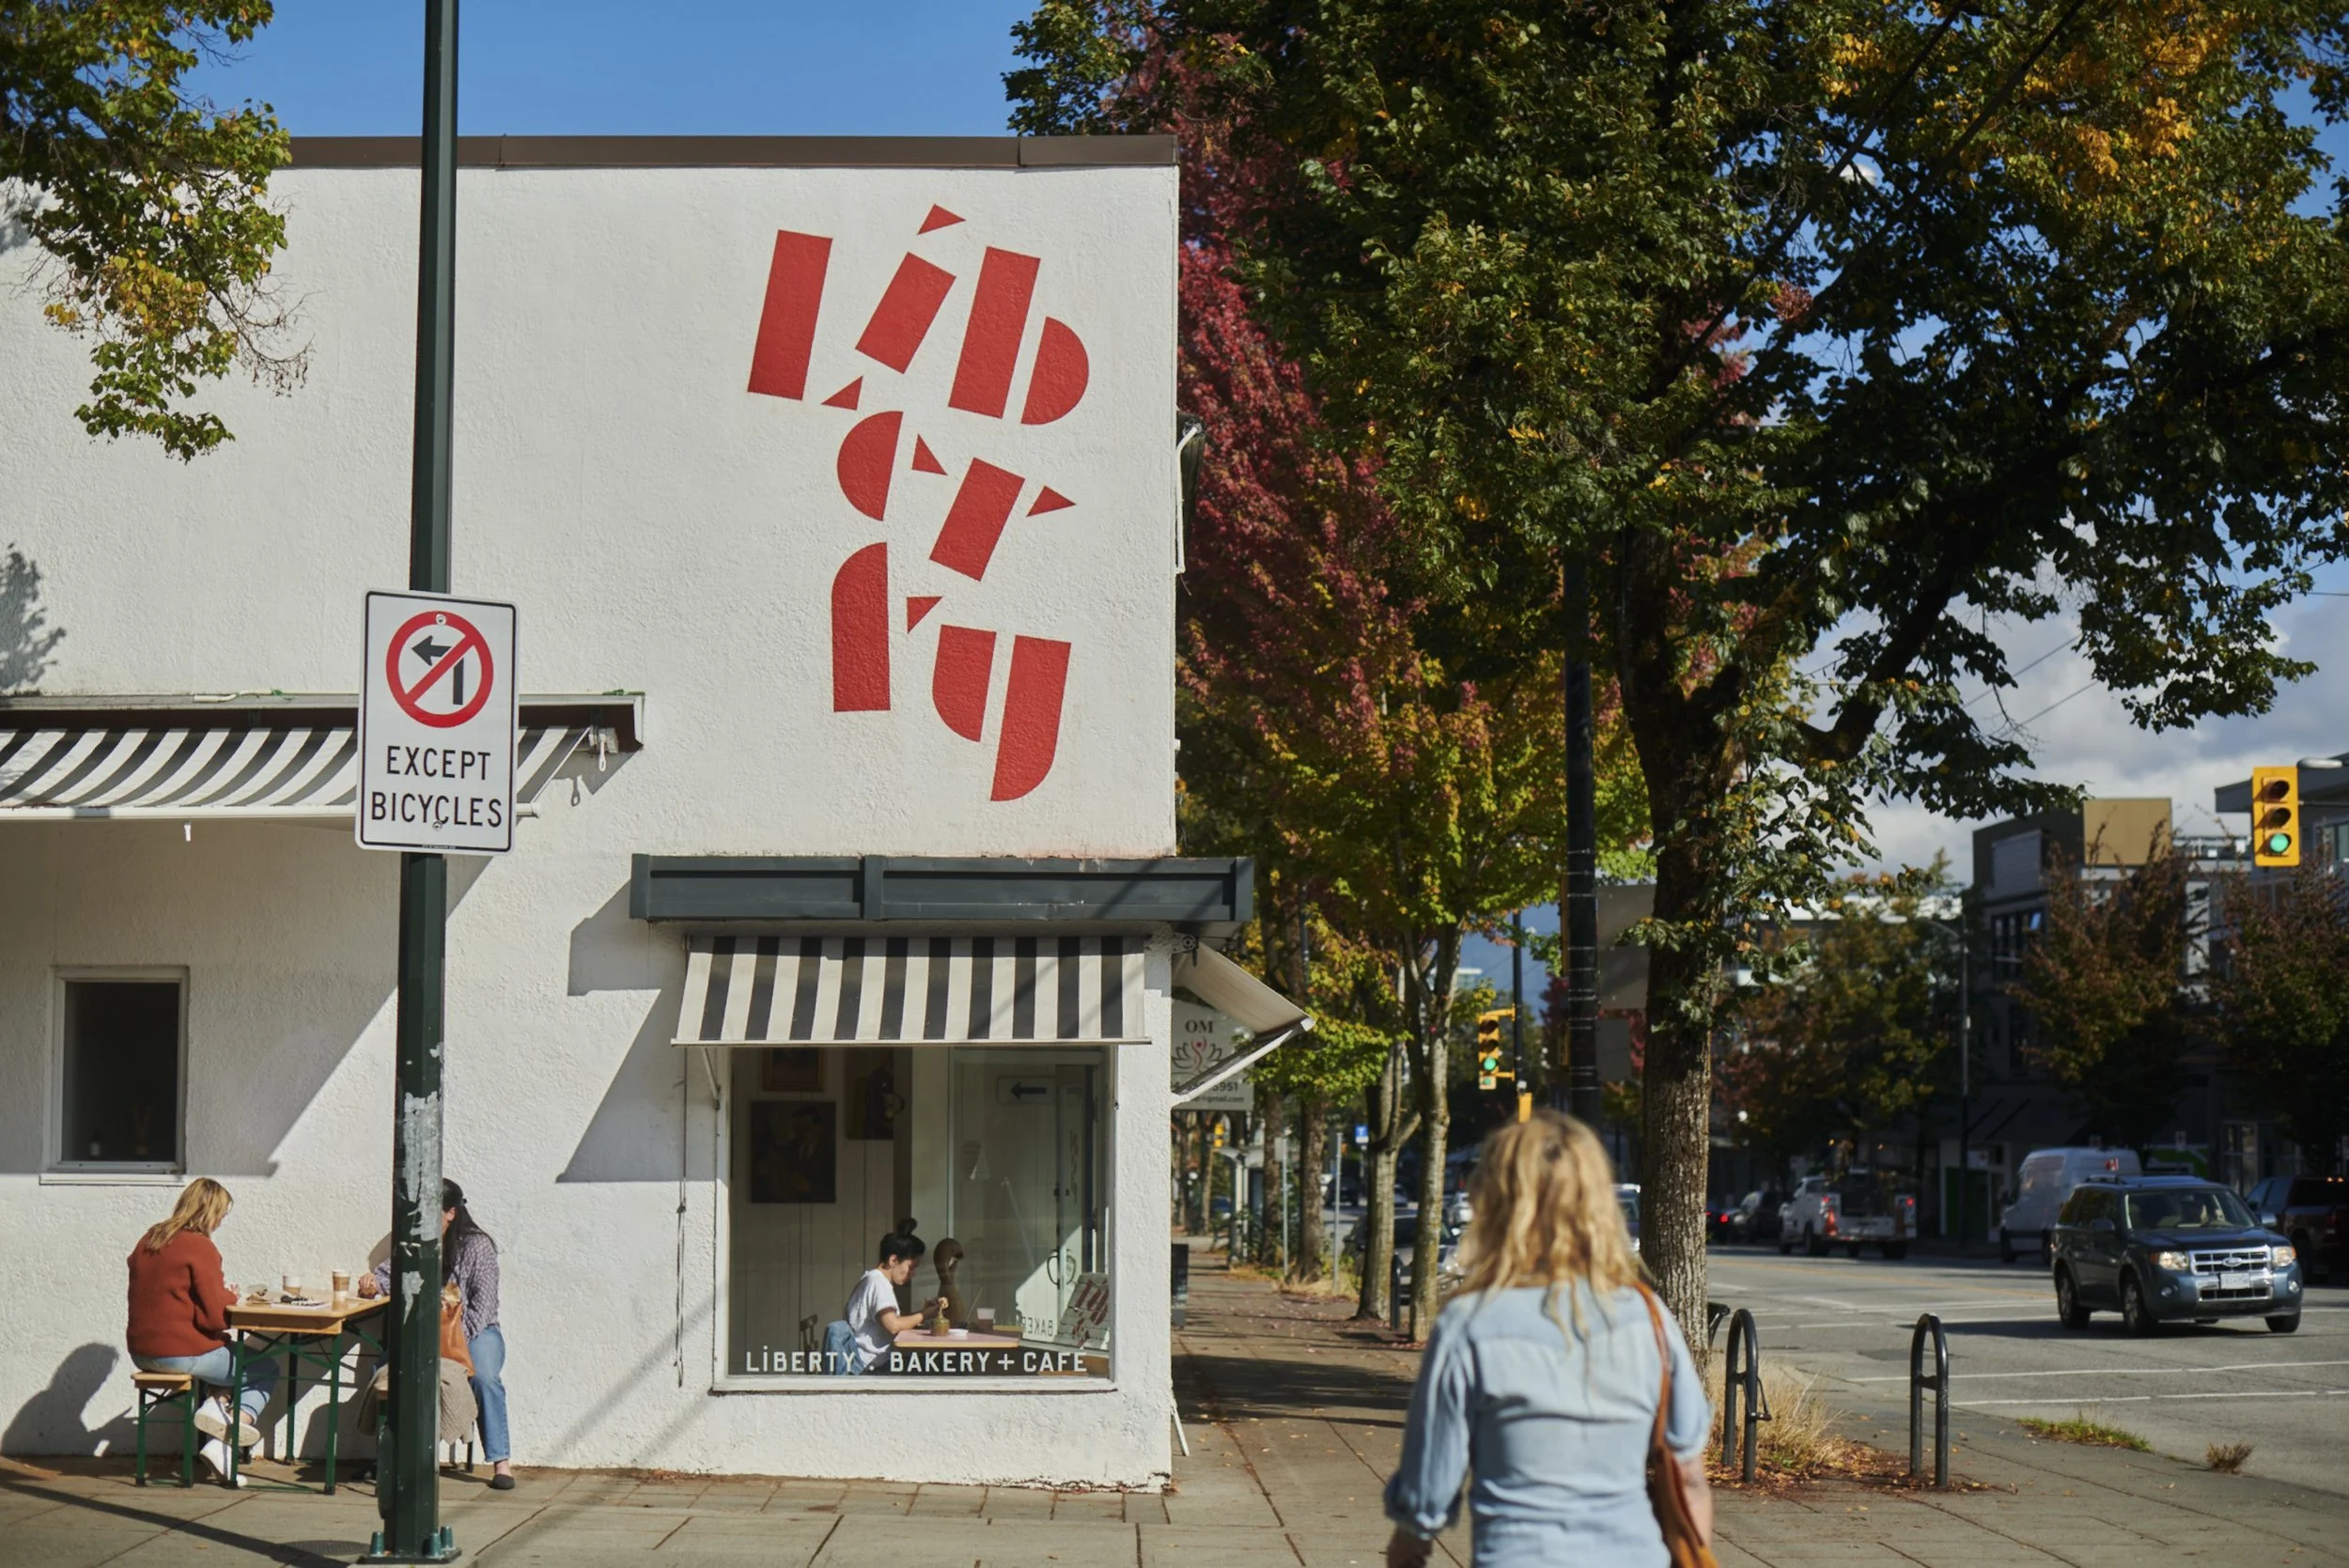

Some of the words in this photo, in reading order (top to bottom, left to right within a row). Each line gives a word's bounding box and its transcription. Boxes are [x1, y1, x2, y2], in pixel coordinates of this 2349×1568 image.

[386, 745, 491, 781] EXCEPT
[371, 791, 503, 828] BICYCLES
[1185, 1019, 1214, 1033] OM
[890, 1351, 991, 1373] BAKERY
[1023, 1352, 1088, 1373] CAFE
